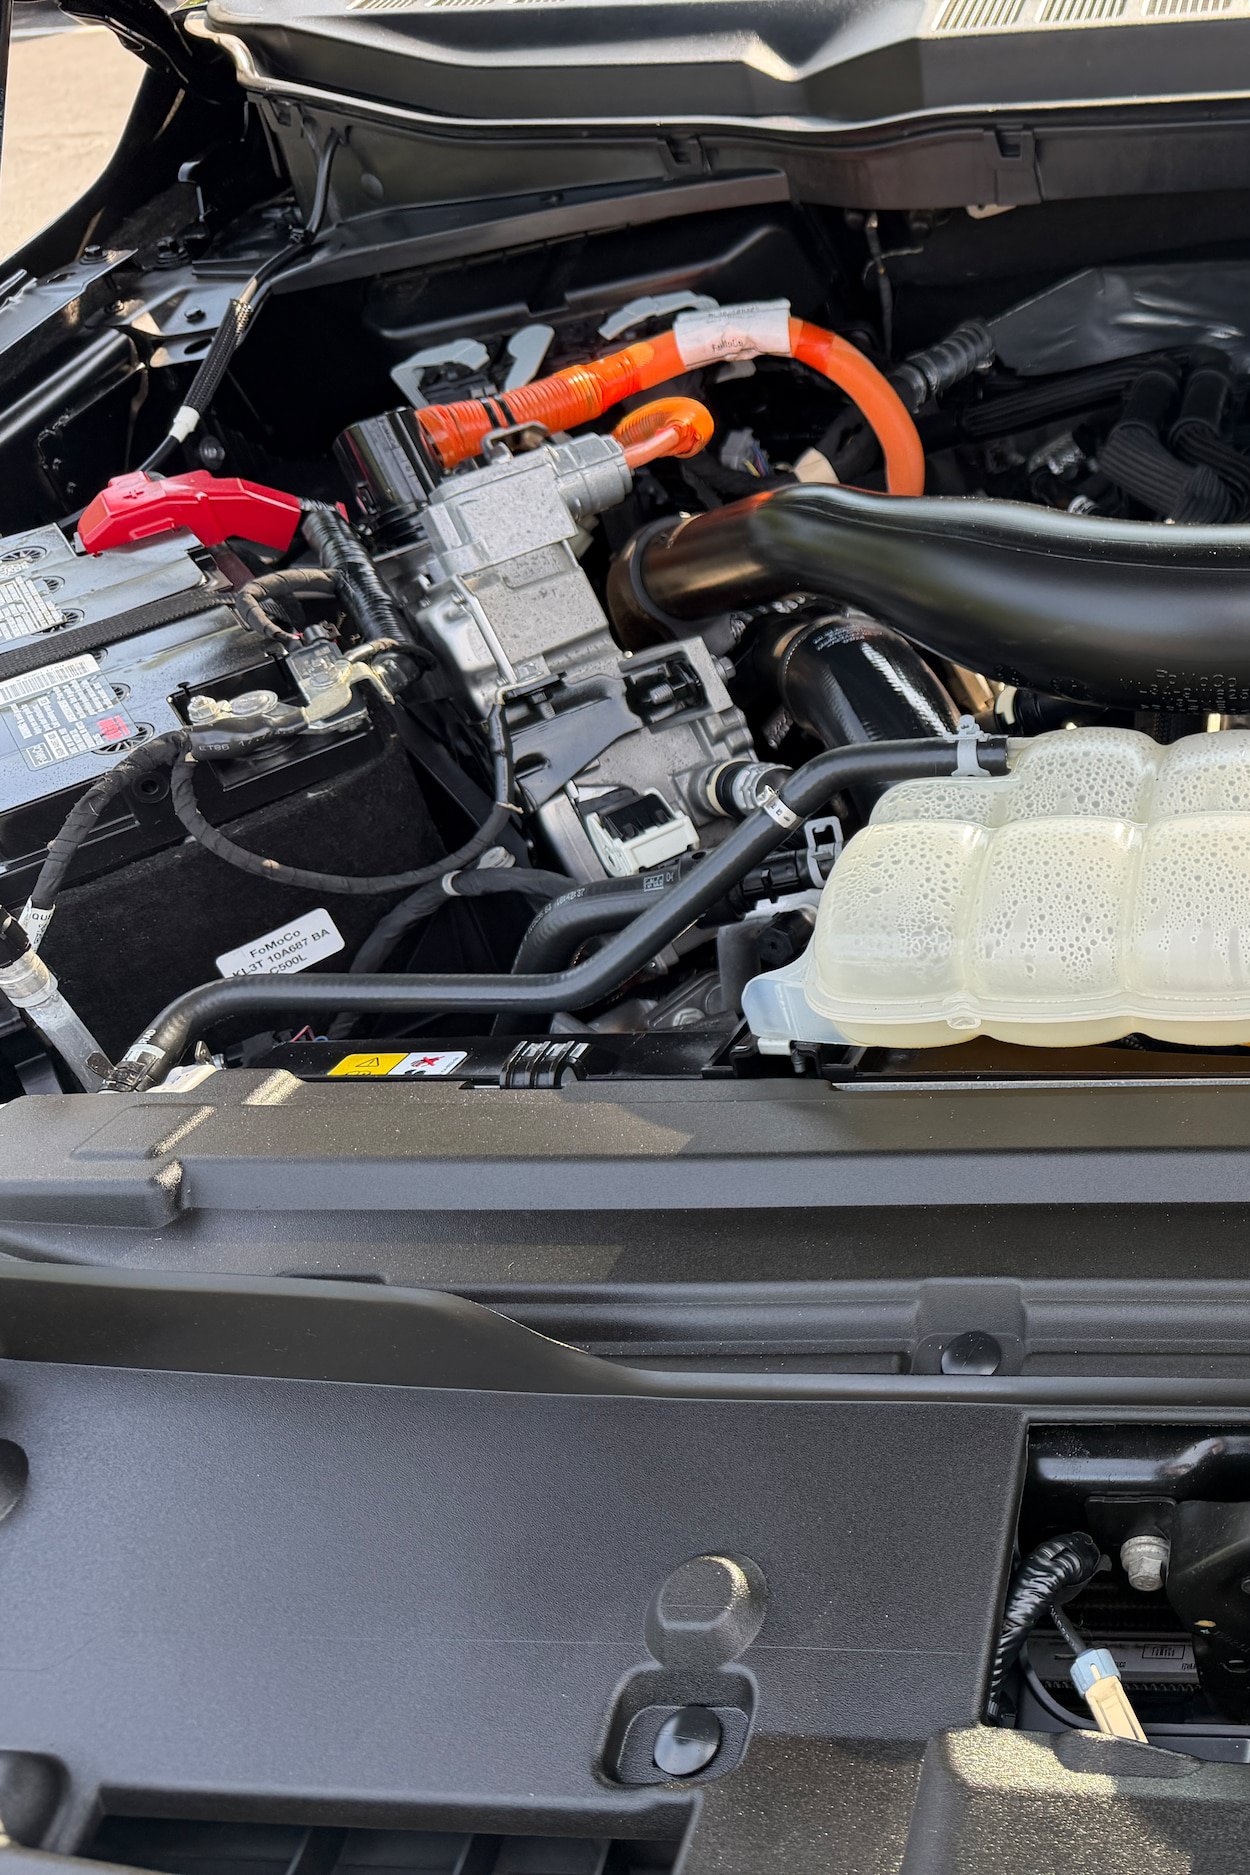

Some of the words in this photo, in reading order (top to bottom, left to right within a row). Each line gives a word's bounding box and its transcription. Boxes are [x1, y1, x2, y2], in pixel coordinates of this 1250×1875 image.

[249, 929, 301, 958] FoMoCo
[267, 938, 309, 963] 10A687
[311, 928, 331, 942] BA
